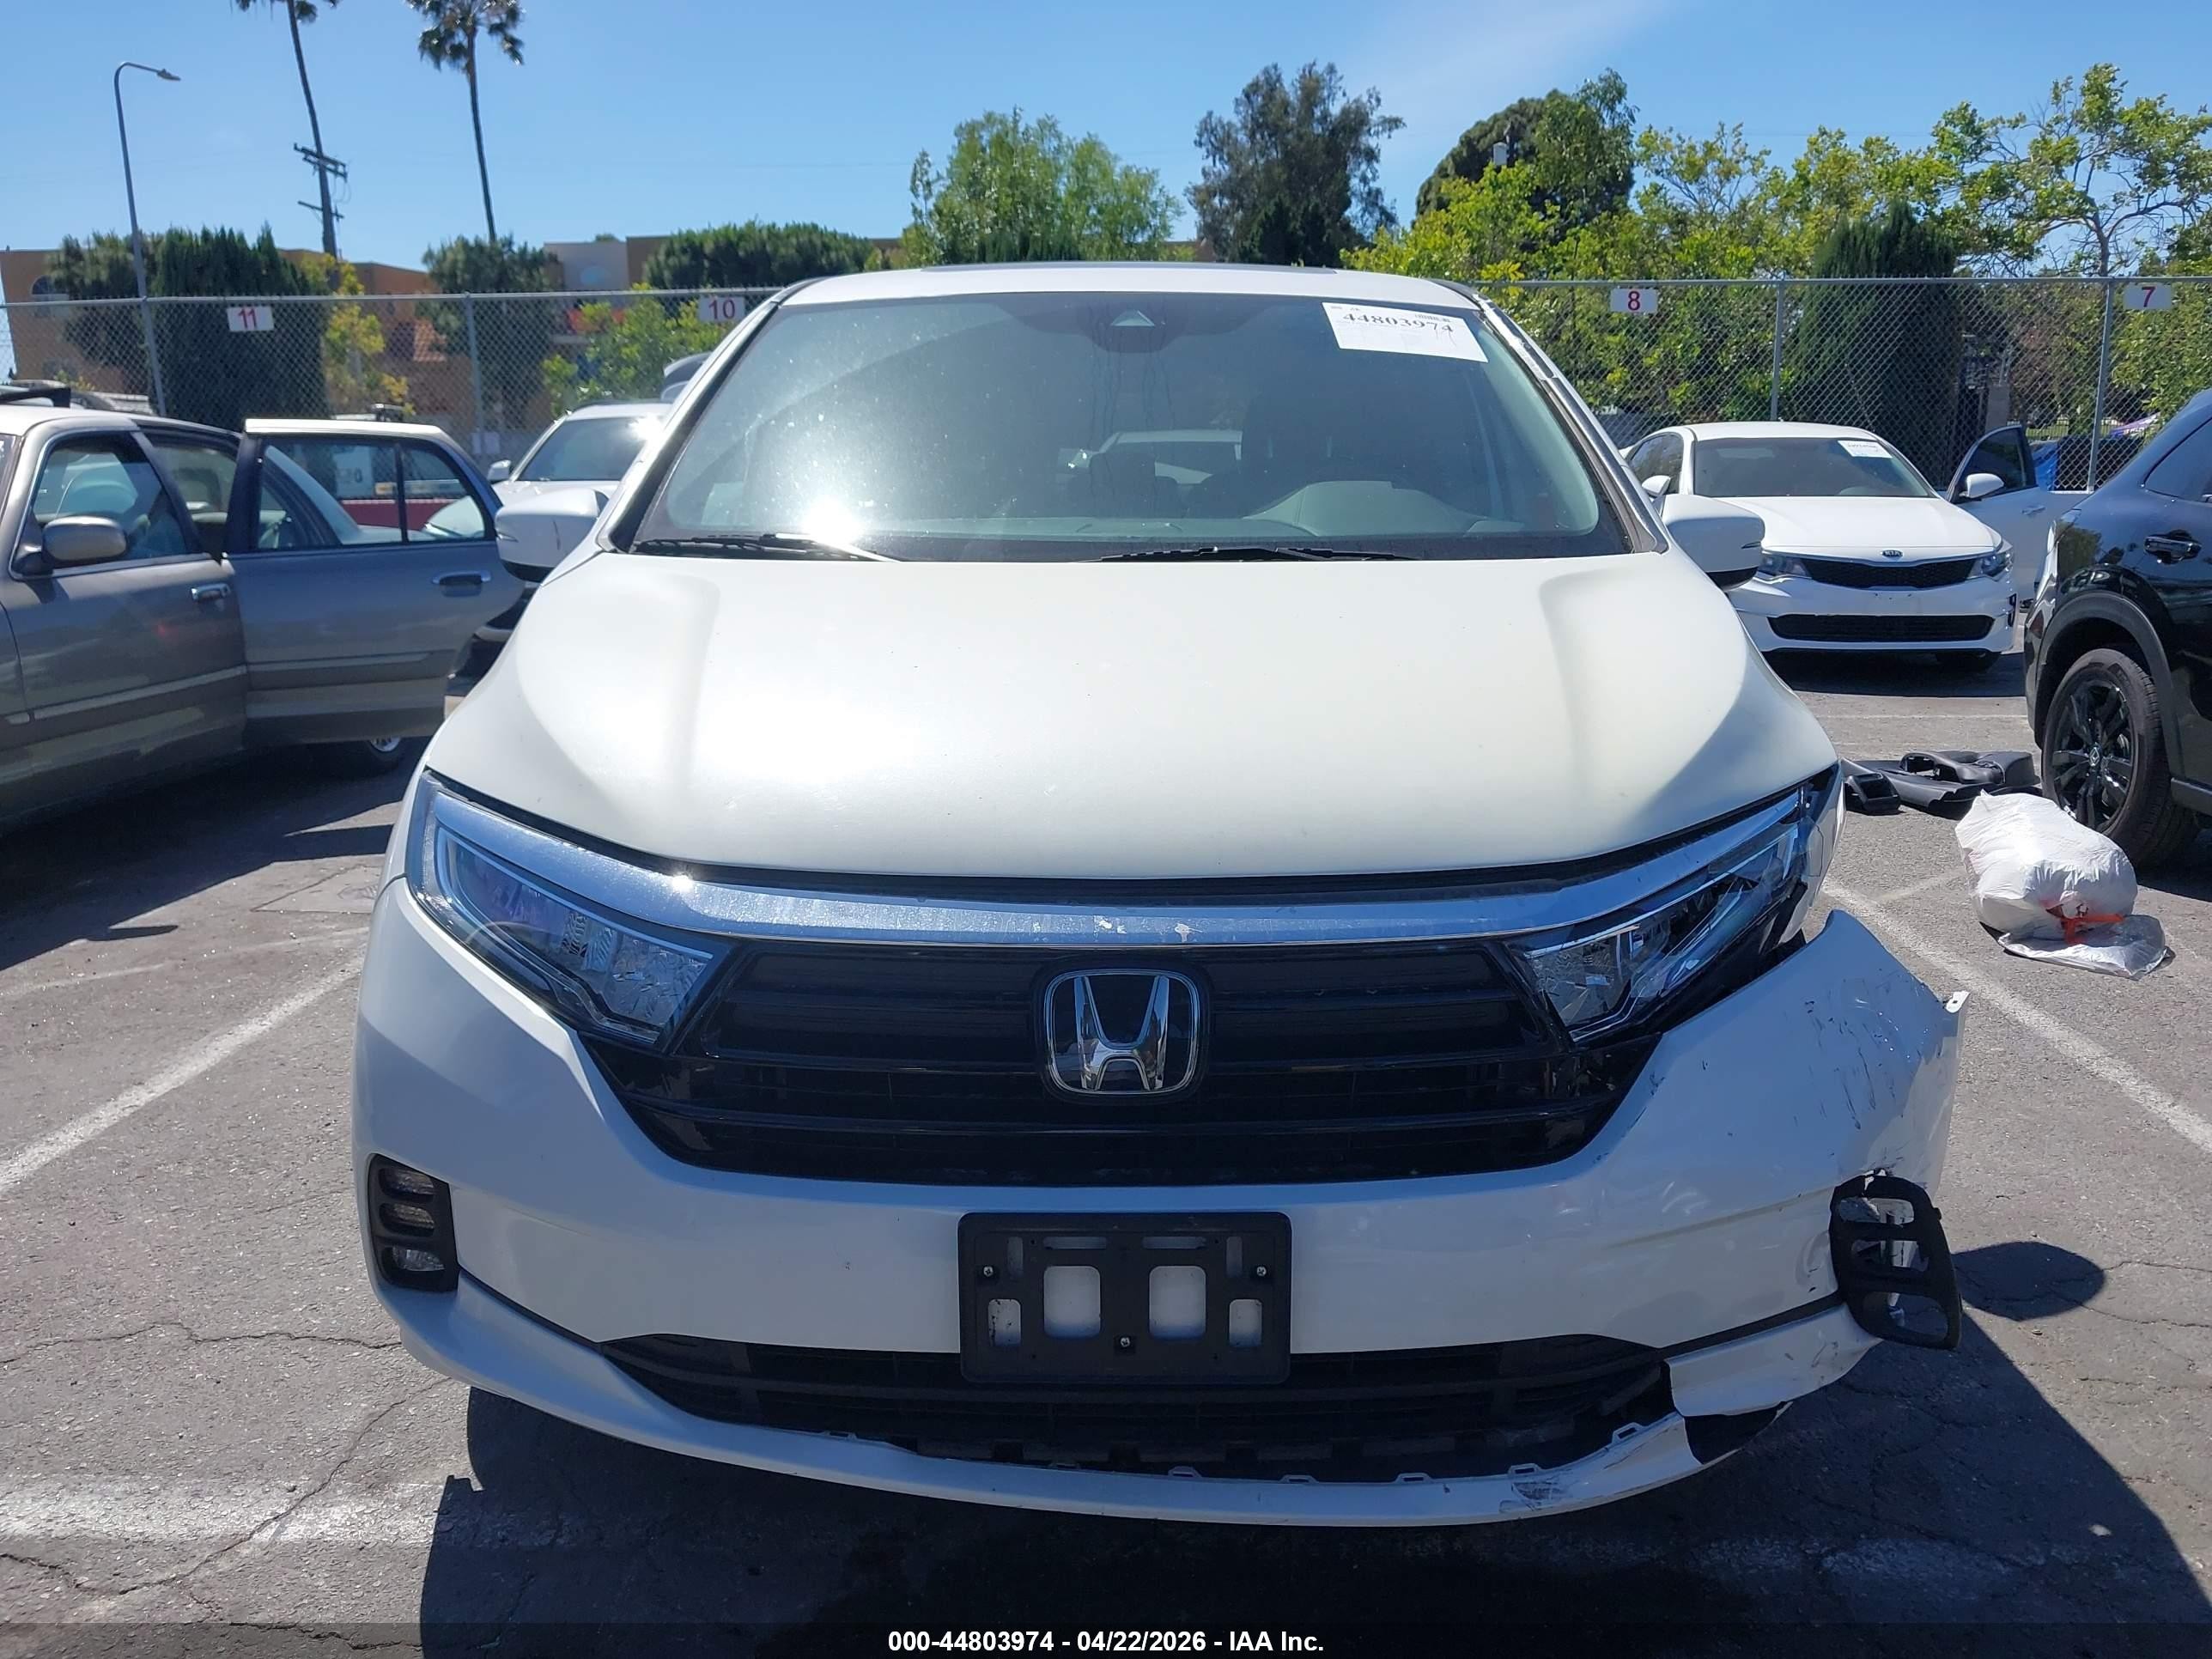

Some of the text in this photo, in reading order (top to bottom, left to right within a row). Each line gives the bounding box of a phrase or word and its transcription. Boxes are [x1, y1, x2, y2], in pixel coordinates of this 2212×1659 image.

[1628, 291, 1640, 310] 8
[2142, 286, 2155, 307] 7
[238, 308, 257, 328] 11
[708, 300, 735, 319] 10
[1343, 313, 1454, 332] 44803974
